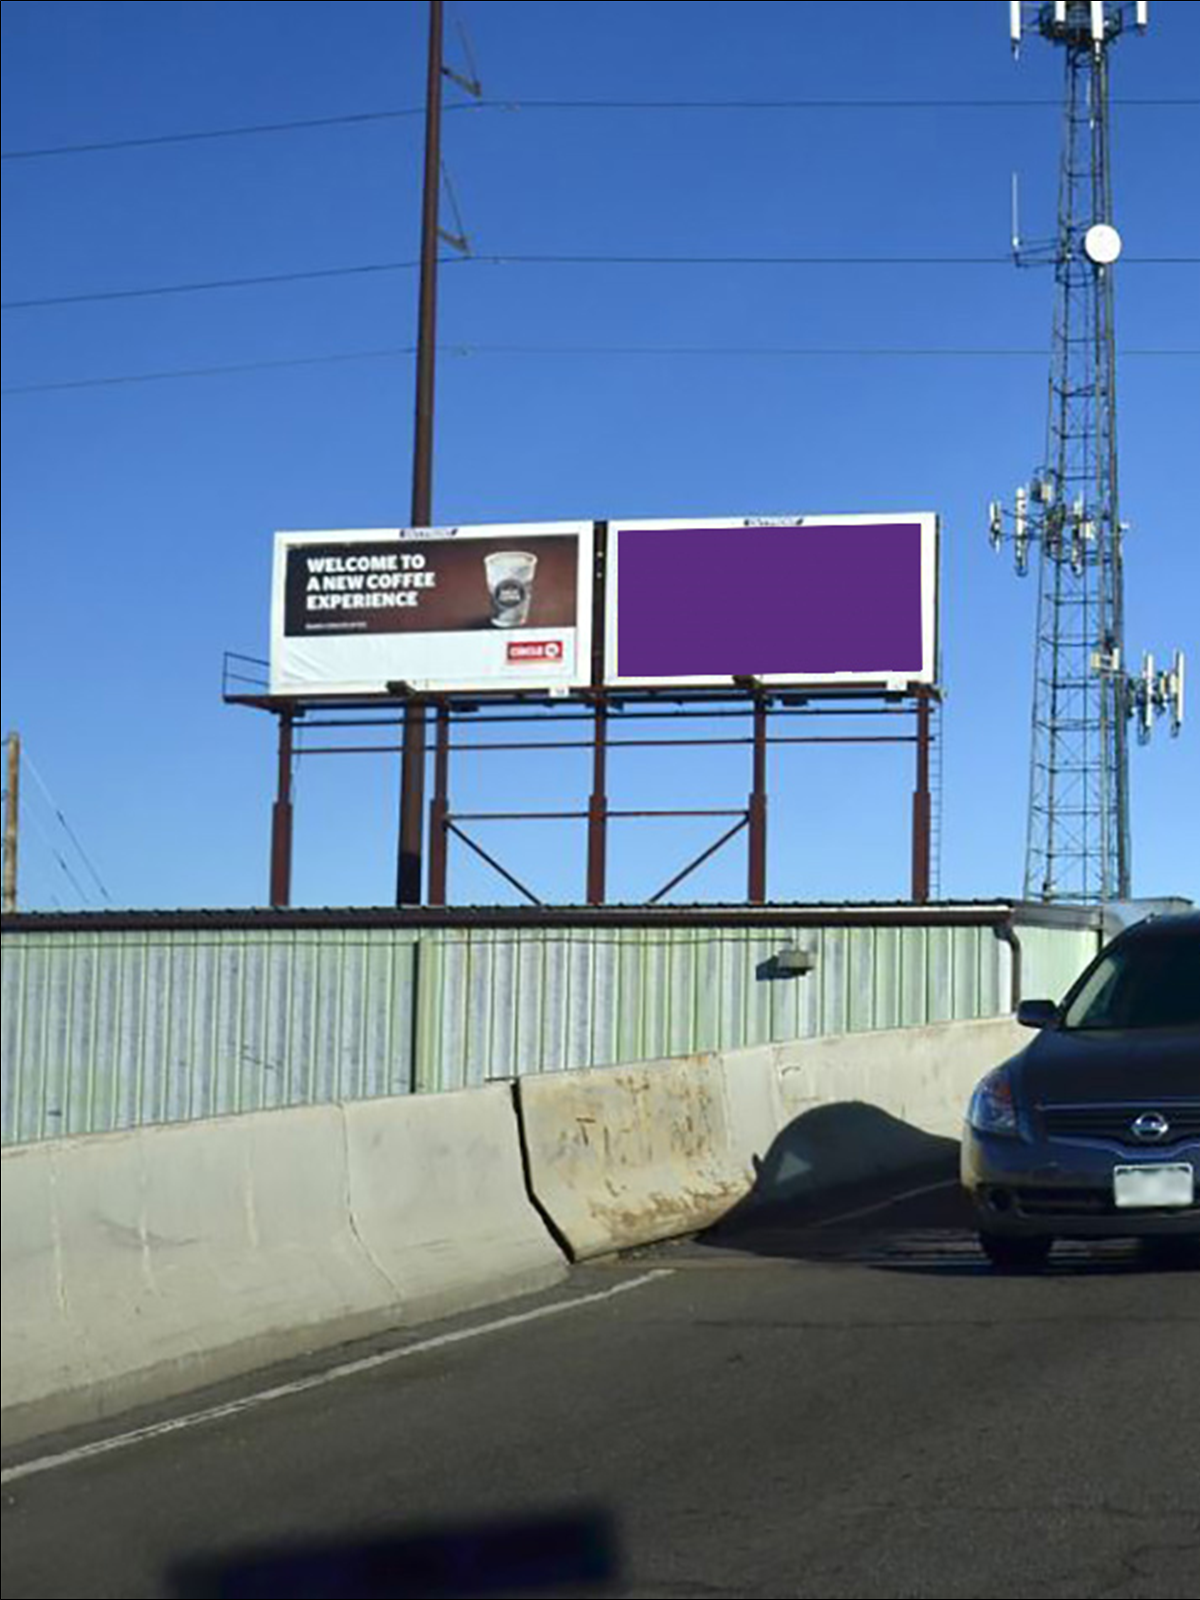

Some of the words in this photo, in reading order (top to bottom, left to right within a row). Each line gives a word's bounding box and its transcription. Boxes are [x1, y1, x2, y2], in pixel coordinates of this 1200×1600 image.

[306, 555, 398, 573] WELCOME
[400, 553, 426, 570] TO
[306, 576, 321, 592] A
[322, 574, 364, 591] NEW
[366, 572, 436, 590] COFFEE
[306, 591, 418, 610] EXPERIENCE
